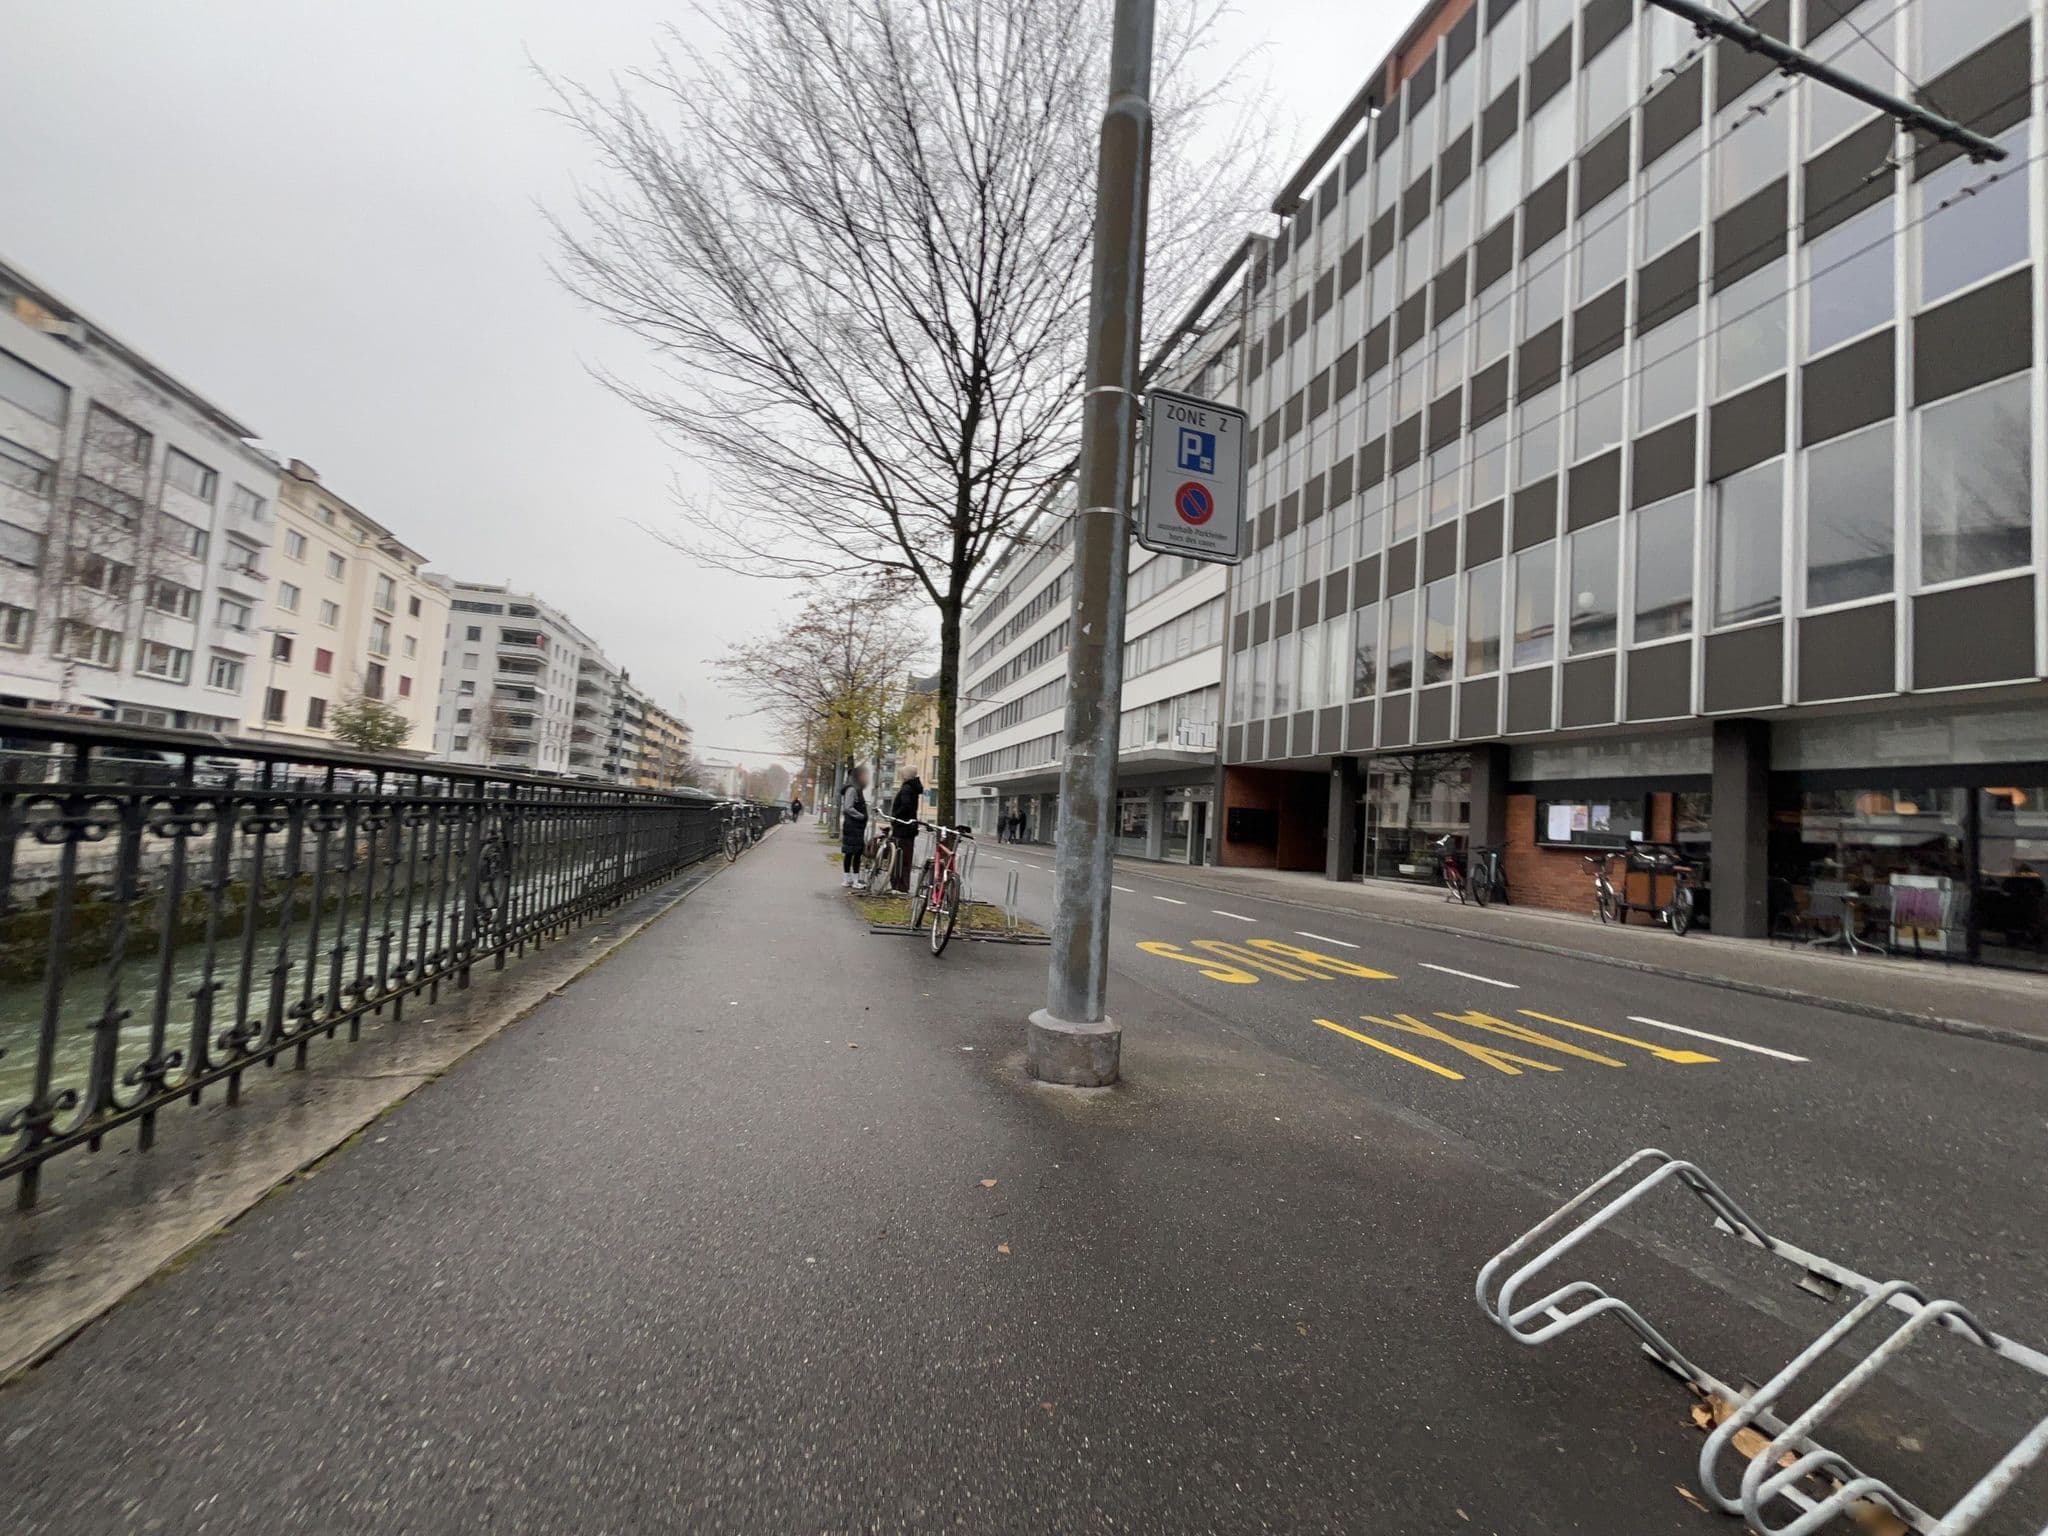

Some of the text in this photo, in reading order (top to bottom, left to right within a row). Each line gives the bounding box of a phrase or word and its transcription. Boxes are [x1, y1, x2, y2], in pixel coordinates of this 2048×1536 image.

[1167, 404, 1227, 432] ZONE Z
[1181, 432, 1203, 466] P
[1135, 938, 1399, 984] BUS
[1311, 1008, 1721, 1081] TAXI
